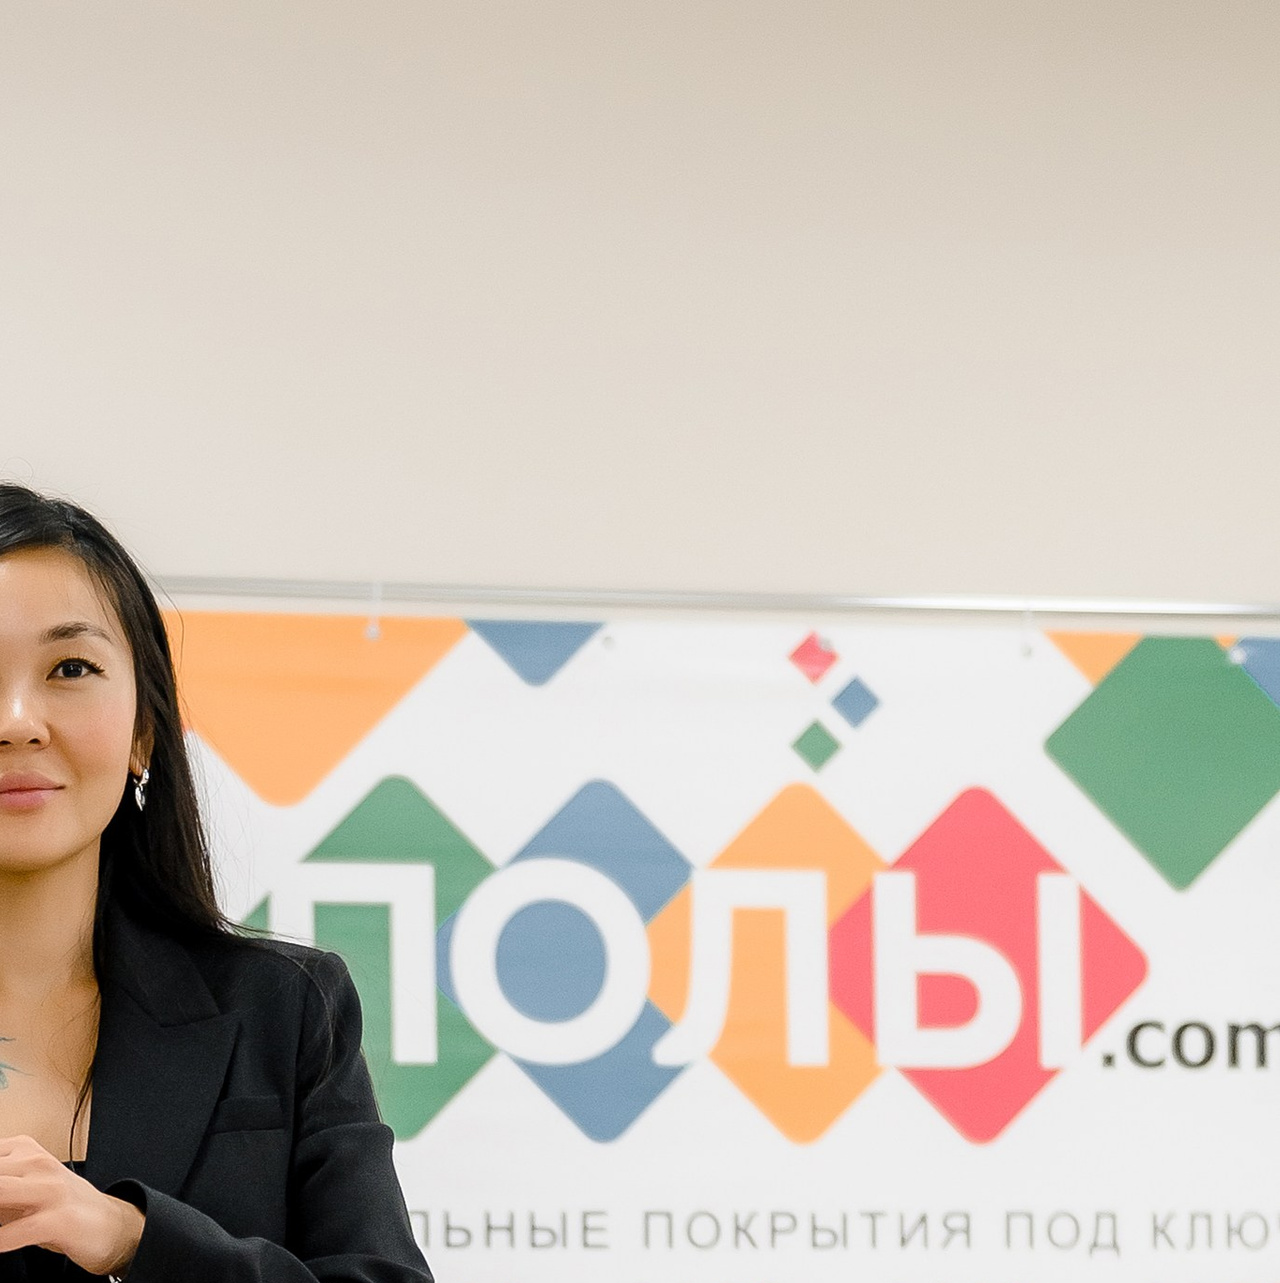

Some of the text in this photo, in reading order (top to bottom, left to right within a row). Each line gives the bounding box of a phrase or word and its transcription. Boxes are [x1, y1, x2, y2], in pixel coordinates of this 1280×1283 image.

[644, 1209, 972, 1251] ПОКРЫТИЯ
[1005, 1210, 1122, 1258] ПОД
[1151, 1210, 1280, 1251] КЛЮ
